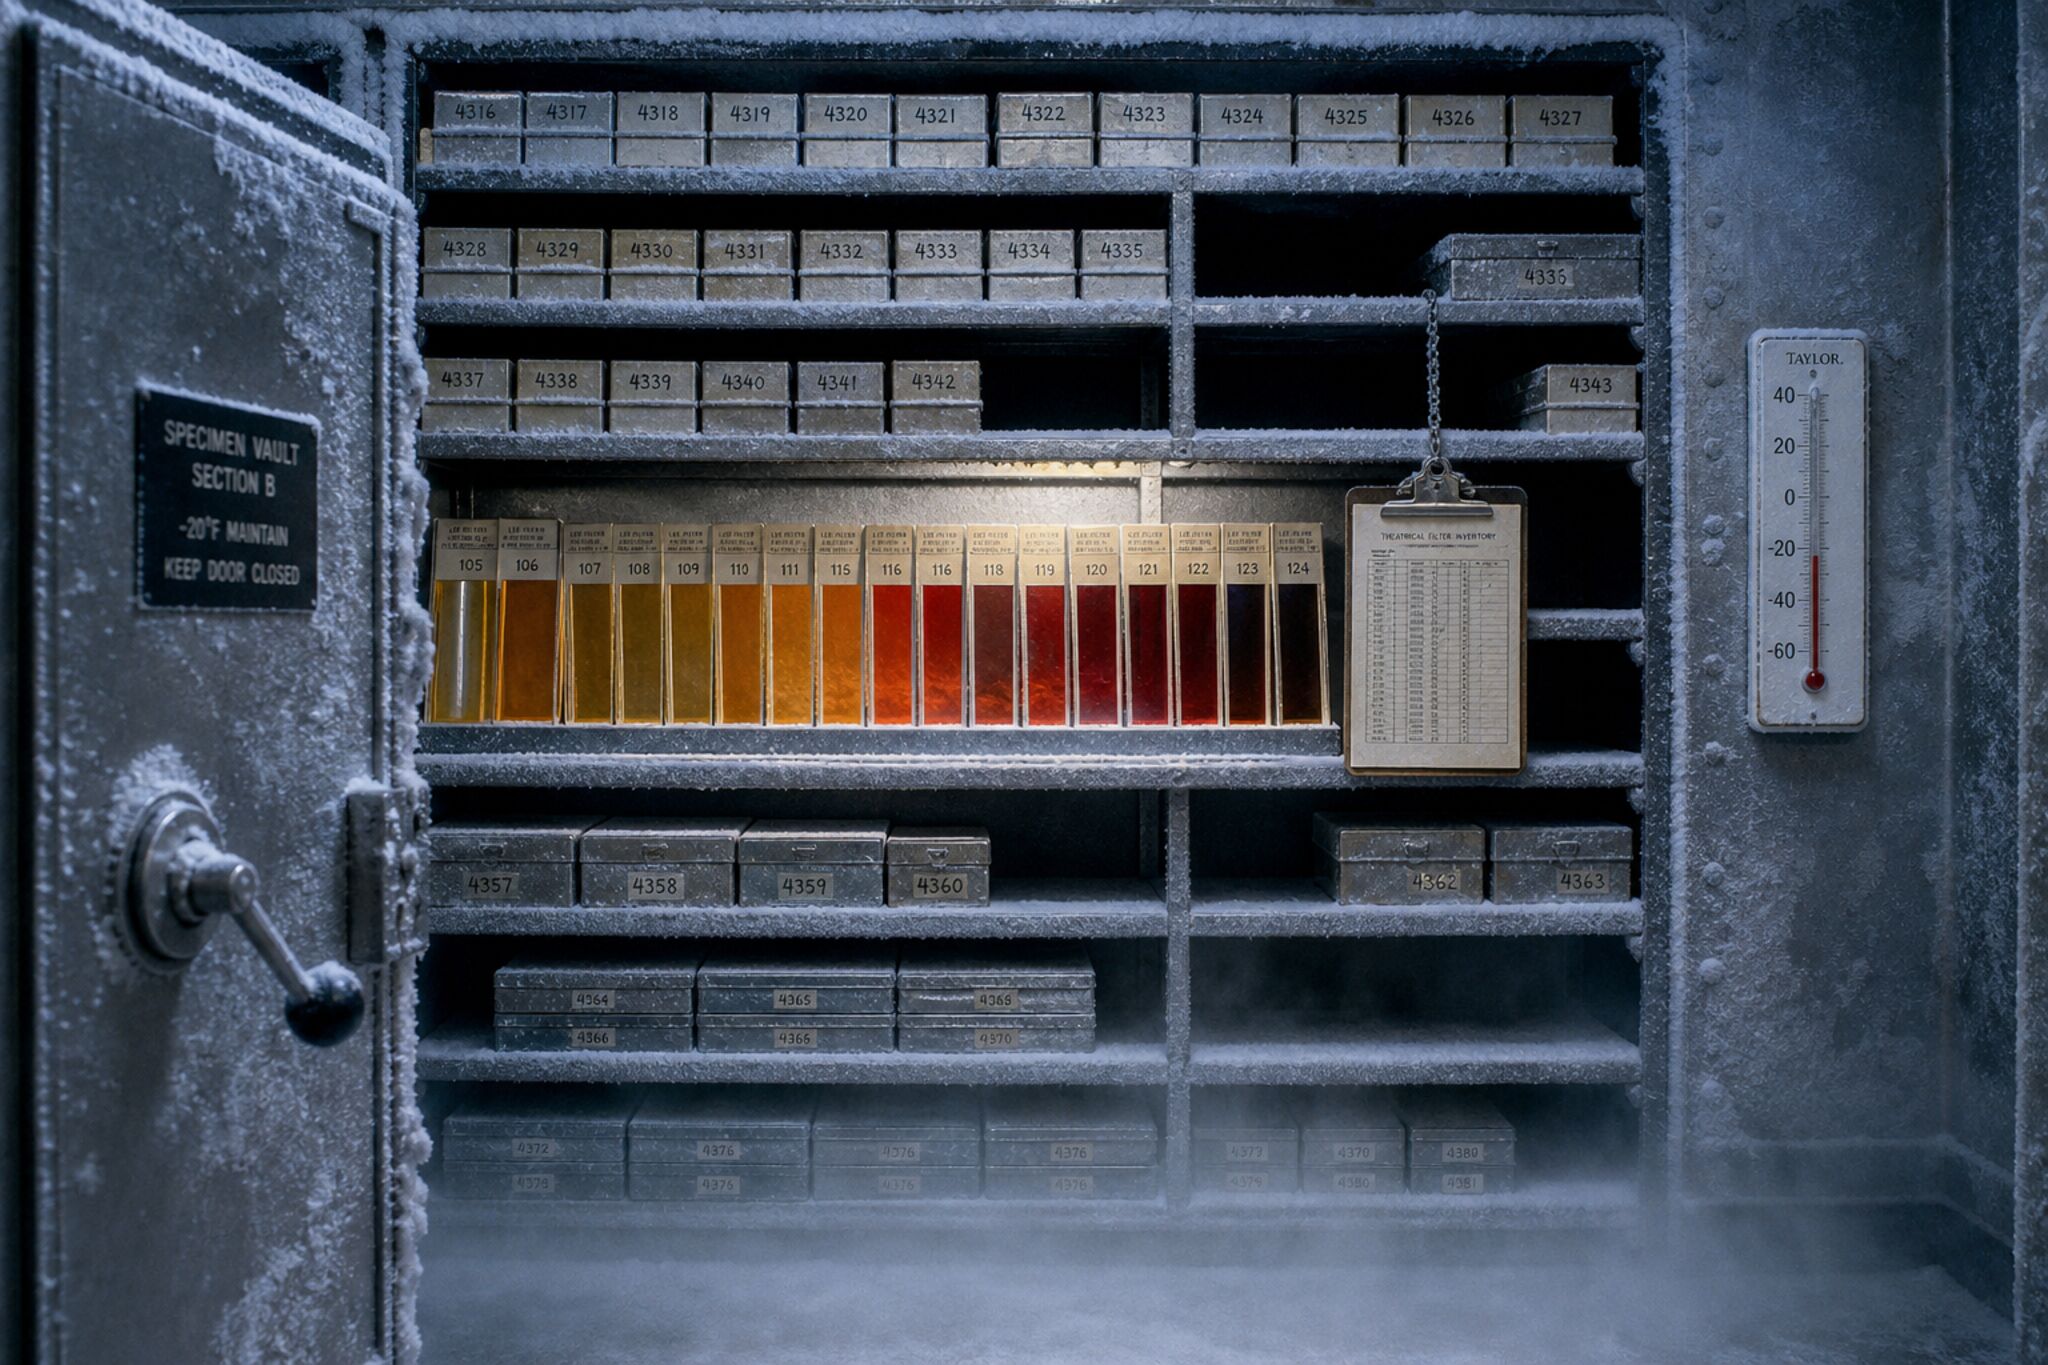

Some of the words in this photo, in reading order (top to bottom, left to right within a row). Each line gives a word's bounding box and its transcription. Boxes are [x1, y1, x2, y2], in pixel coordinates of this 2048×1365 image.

[455, 104, 496, 120] 4316
[546, 104, 586, 120] 4317
[638, 104, 678, 121] 4318
[730, 106, 770, 122] 4319
[824, 105, 867, 121] 4320
[915, 107, 955, 123] 4321
[1022, 104, 1065, 121] 4322
[1123, 105, 1165, 122] 4323
[1221, 108, 1263, 124] 4324
[1325, 108, 1367, 125] 4325
[1432, 109, 1474, 125] 4326
[1540, 109, 1581, 125] 4327
[443, 241, 486, 257] 4328
[536, 242, 578, 258] 4329
[631, 243, 672, 258] 4330
[725, 243, 764, 260] 4331
[820, 243, 863, 259] 4332
[915, 243, 957, 259] 4333
[1008, 243, 1050, 259] 4334
[1101, 242, 1143, 258] 4335
[441, 372, 484, 388] 4337
[535, 372, 577, 389] 4338
[629, 373, 671, 390] 4339
[722, 374, 764, 390] 4340
[818, 375, 856, 391] 4341
[912, 373, 955, 390] 4342
[1570, 377, 1612, 393] 4343
[1773, 387, 1795, 403] 40
[164, 420, 245, 456] SPECIMEN
[253, 436, 300, 466] VAULT
[1774, 438, 1795, 454] 20
[192, 463, 258, 493] SECTION
[265, 475, 276, 498] B
[1784, 489, 1795, 505] 0
[178, 516, 220, 541] -20°F
[227, 522, 288, 546] MAINTAIN
[1768, 540, 1795, 556] -20
[163, 557, 202, 581] KEEP
[207, 560, 246, 583] DOOR
[251, 562, 300, 586] CLOSED
[460, 559, 483, 571] 105
[517, 559, 539, 571] 106
[580, 562, 600, 575] 107
[628, 563, 650, 575] 108
[678, 563, 699, 575] 109
[731, 563, 749, 575] 110
[781, 563, 798, 576] 111
[882, 564, 902, 576] 116
[933, 564, 952, 576] 116
[984, 564, 1004, 576] 118
[1035, 564, 1055, 576] 119
[1086, 564, 1107, 576] 120
[1139, 564, 1157, 575] 121
[1188, 563, 1209, 575] 122
[1237, 563, 1258, 575] 123
[1287, 562, 1309, 574] 124
[1768, 592, 1795, 608] -40
[1767, 643, 1795, 659] -60
[468, 876, 512, 894] 4357
[632, 877, 677, 895] 4358
[782, 877, 826, 896] 4359
[917, 877, 963, 895] 4360
[1412, 873, 1457, 891] 4362
[1560, 873, 1605, 889] 4363
[577, 1032, 609, 1044] 4366
